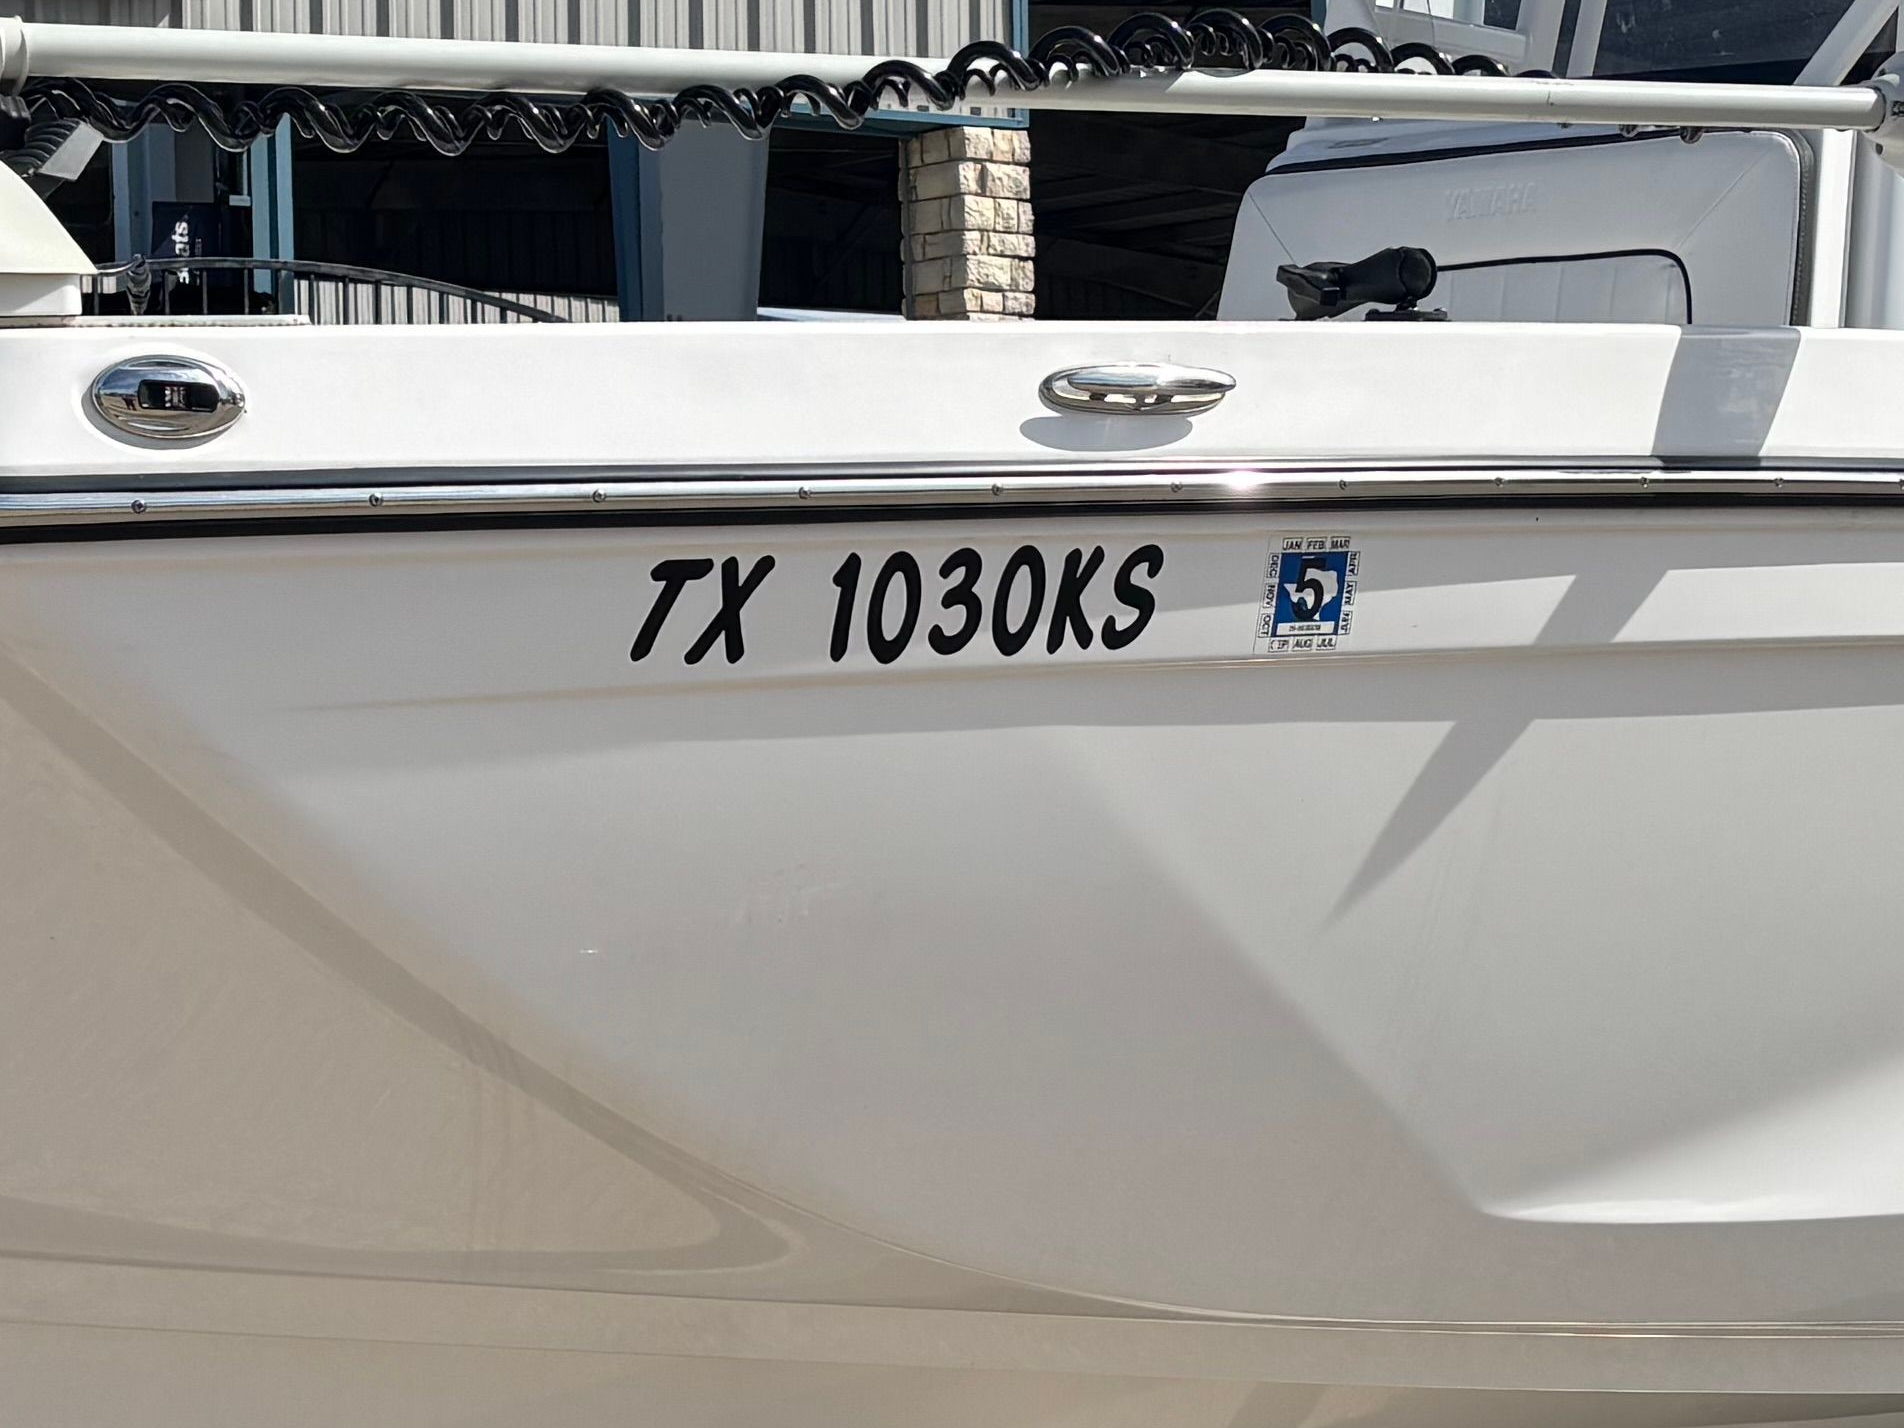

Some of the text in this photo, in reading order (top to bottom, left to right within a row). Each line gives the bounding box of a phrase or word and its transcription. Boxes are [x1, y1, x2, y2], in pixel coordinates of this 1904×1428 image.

[629, 543, 1165, 665] TX 1030KS
[1291, 556, 1326, 622] 5
